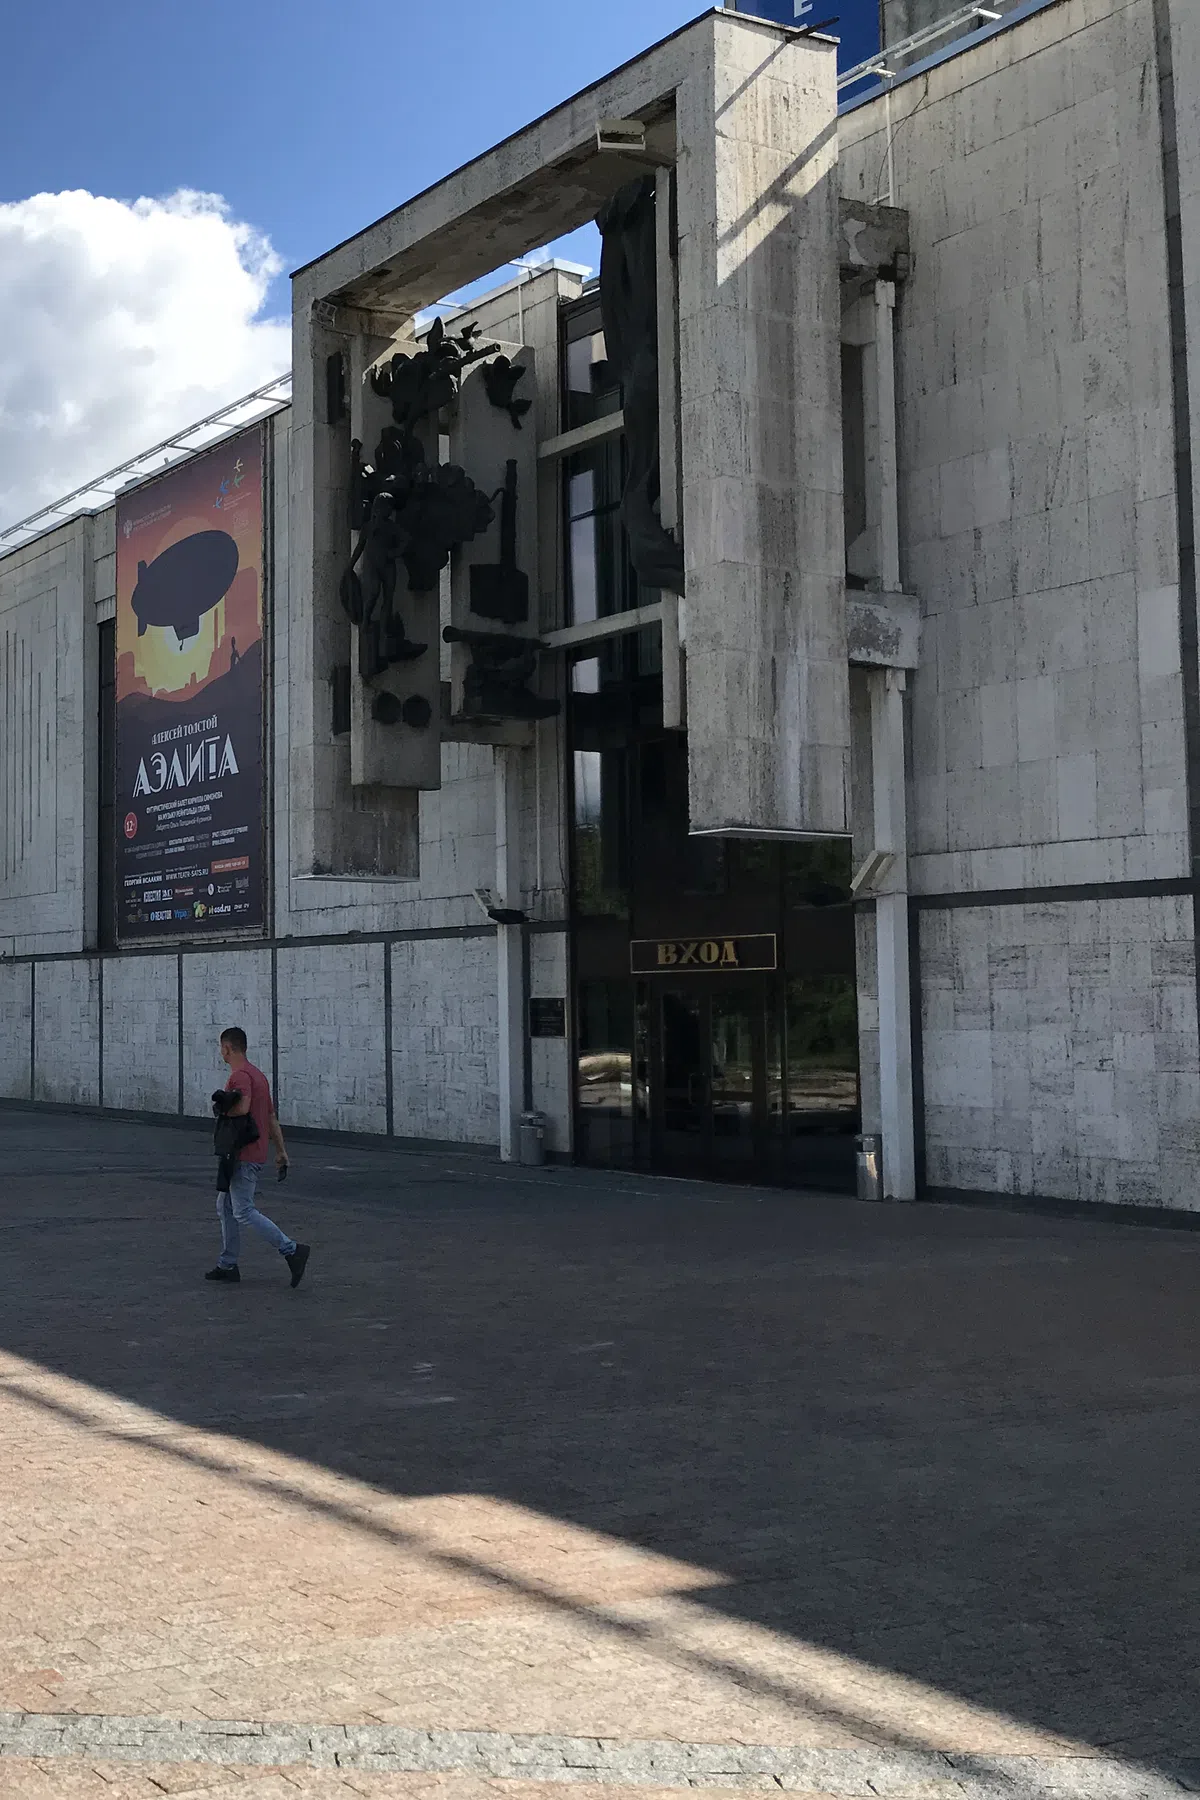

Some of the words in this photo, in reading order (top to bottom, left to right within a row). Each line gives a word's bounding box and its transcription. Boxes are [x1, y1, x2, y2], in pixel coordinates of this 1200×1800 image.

[151, 724, 183, 745] АЛЕКСЕЙ
[183, 714, 218, 737] ТОЛСТОЙ
[132, 733, 240, 798] АЭЛИТА
[657, 941, 739, 967] ВХОД
